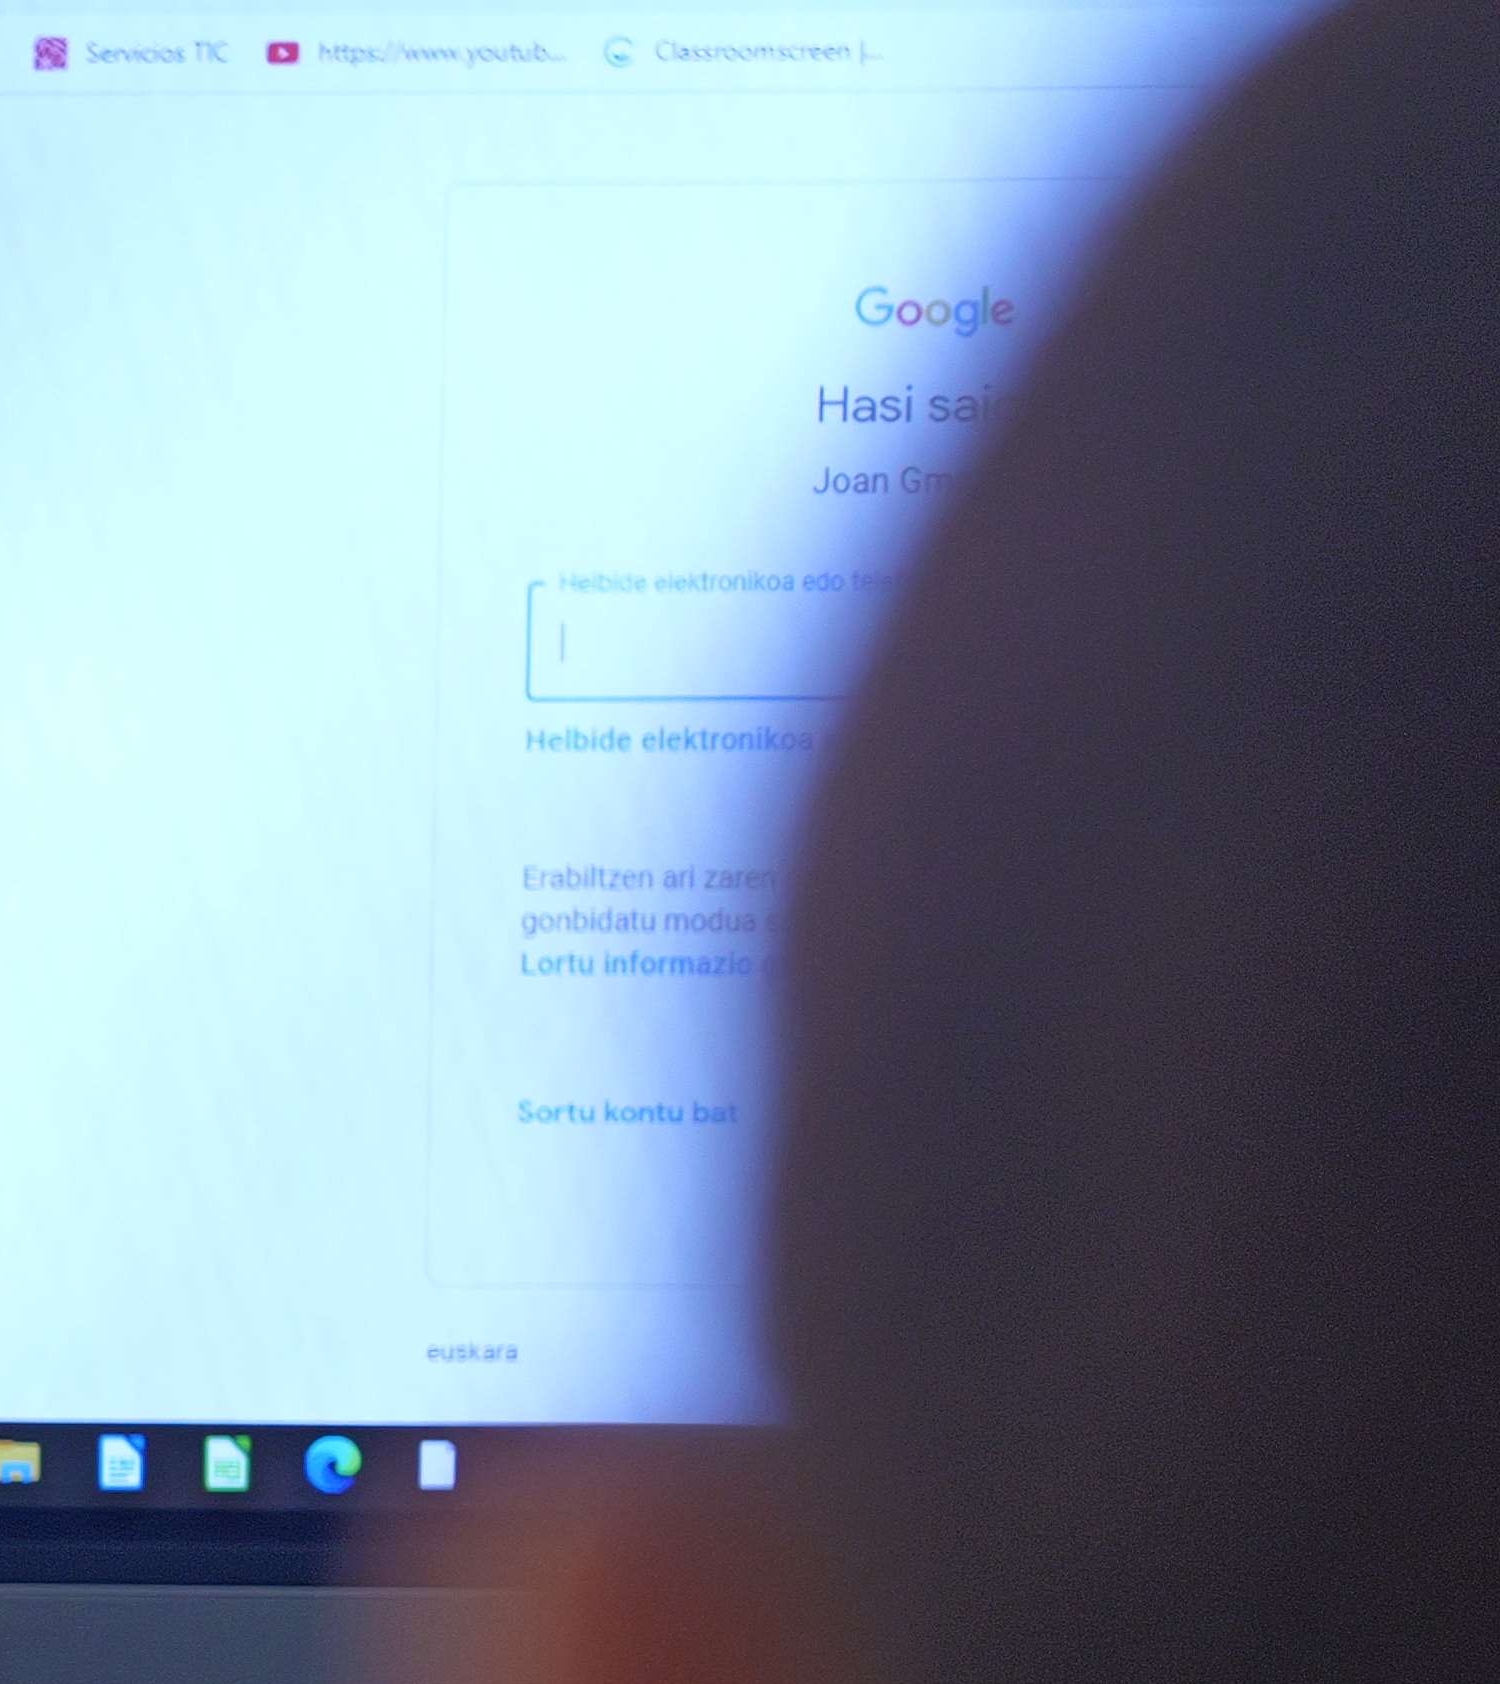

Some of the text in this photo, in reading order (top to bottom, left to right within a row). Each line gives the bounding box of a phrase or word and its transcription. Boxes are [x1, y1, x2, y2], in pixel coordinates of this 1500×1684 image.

[86, 41, 185, 64] Servicios
[655, 39, 850, 62] Classroomscreen
[855, 285, 1015, 338] Google
[817, 383, 913, 423] Hasi
[812, 465, 889, 495] Joan
[558, 570, 647, 594] Helbide
[654, 570, 795, 593] elektronikoa
[802, 570, 845, 592] edo
[525, 725, 814, 753] Helbide elektronikoa
[522, 863, 653, 890] Erabiltzen
[662, 864, 696, 890] ari
[520, 907, 656, 939] gonbidatu
[663, 909, 757, 933] modua
[520, 950, 595, 976] Lortu
[603, 949, 752, 976] informazio
[517, 1100, 739, 1124] Sortu kontu bat
[427, 1340, 518, 1362] euskara
